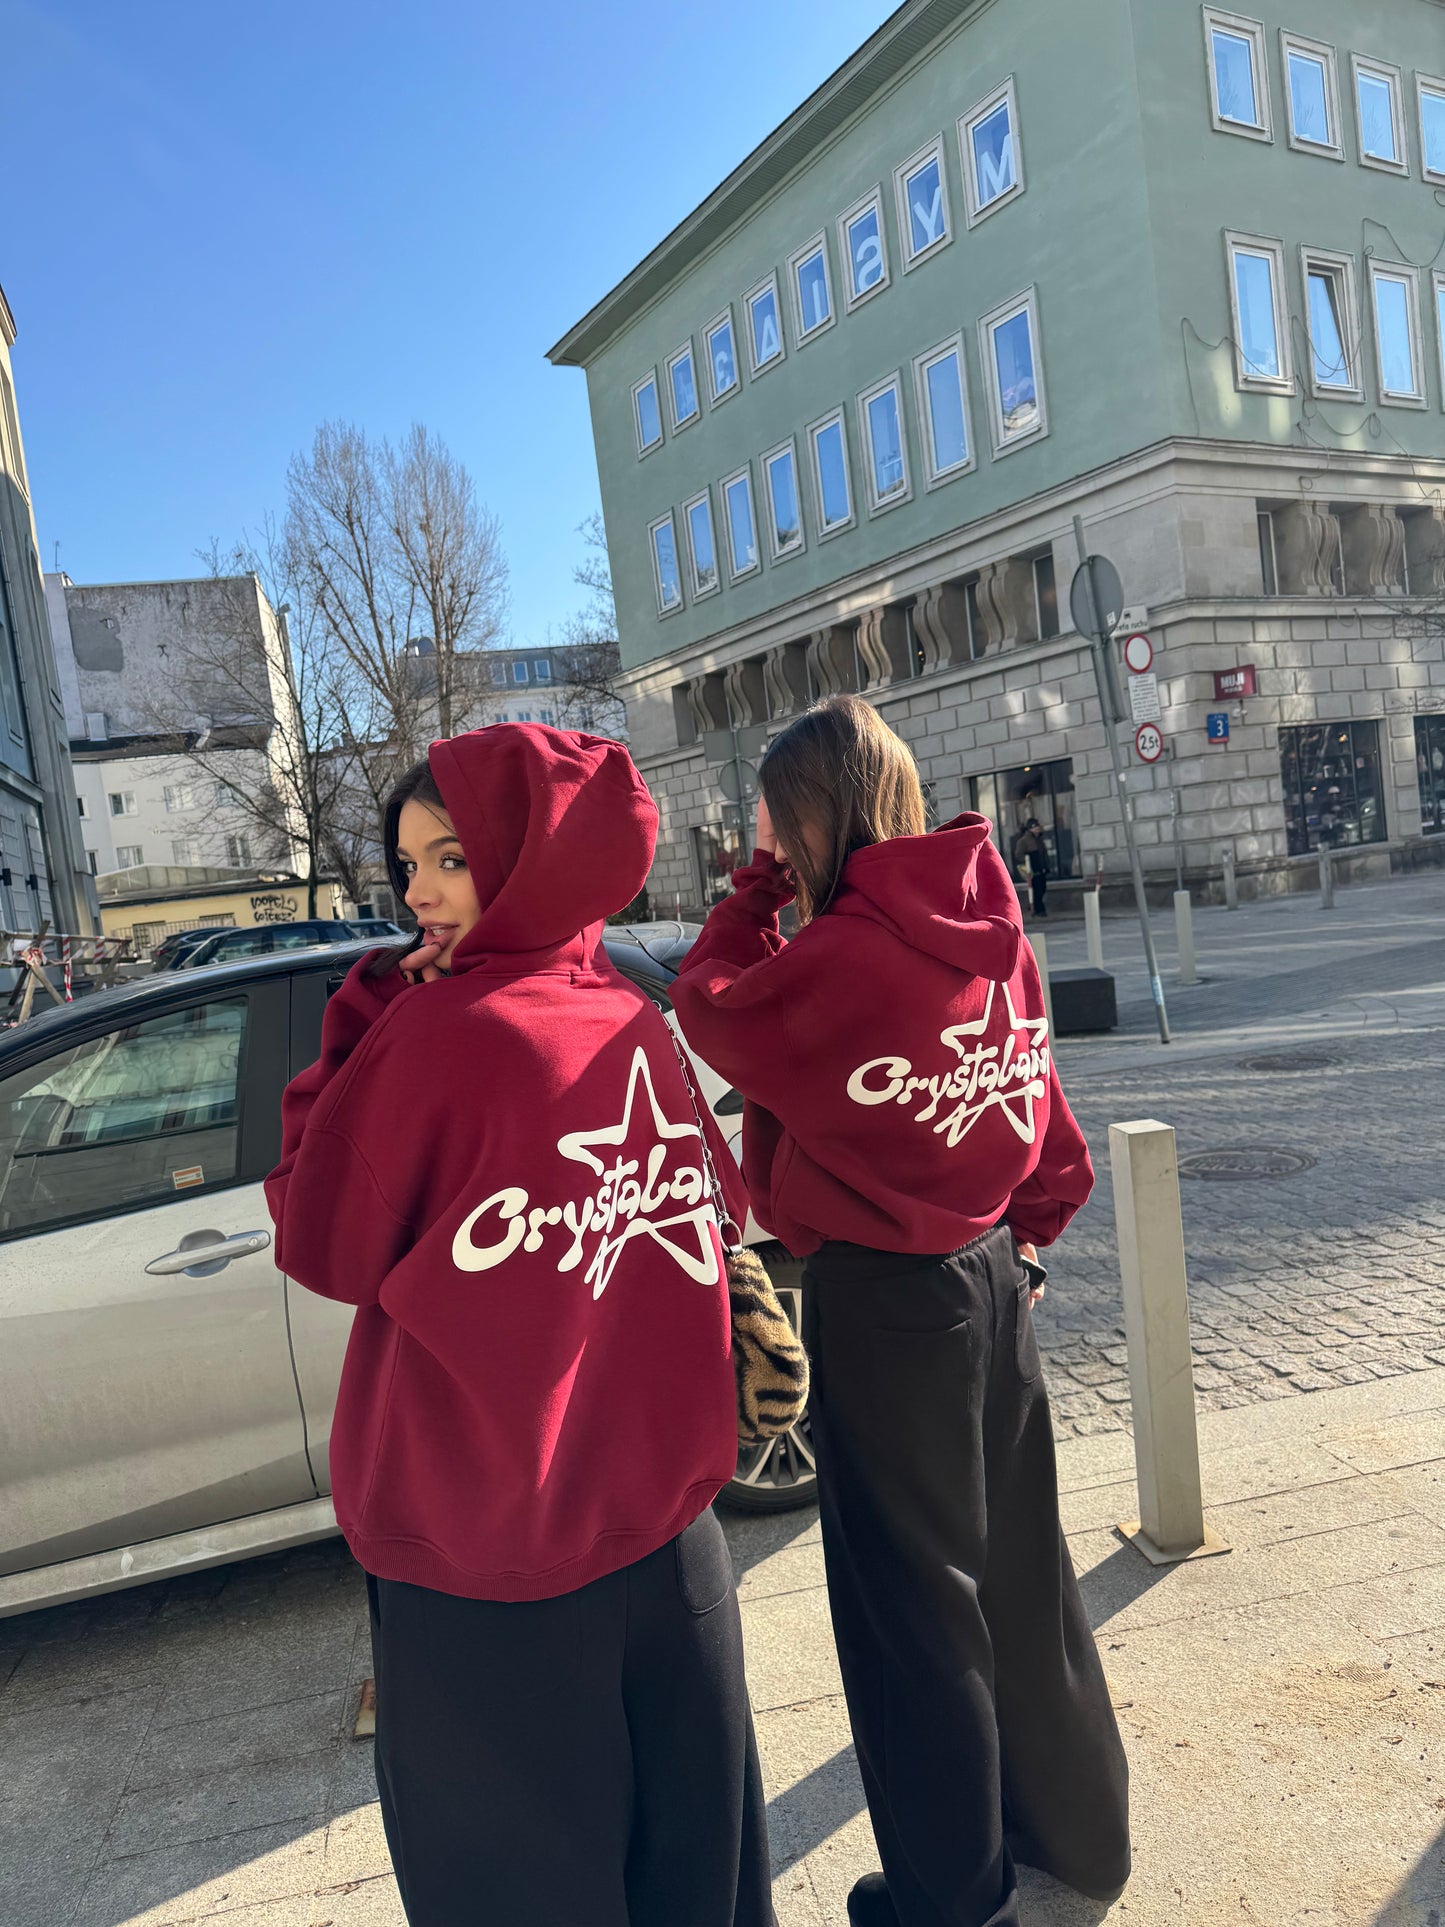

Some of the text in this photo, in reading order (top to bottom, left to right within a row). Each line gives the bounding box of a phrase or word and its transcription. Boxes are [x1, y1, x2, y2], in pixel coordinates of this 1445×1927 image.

[1221, 672, 1245, 689] MUJI
[1216, 719, 1224, 737] 3
[1140, 734, 1159, 752] 2,5t
